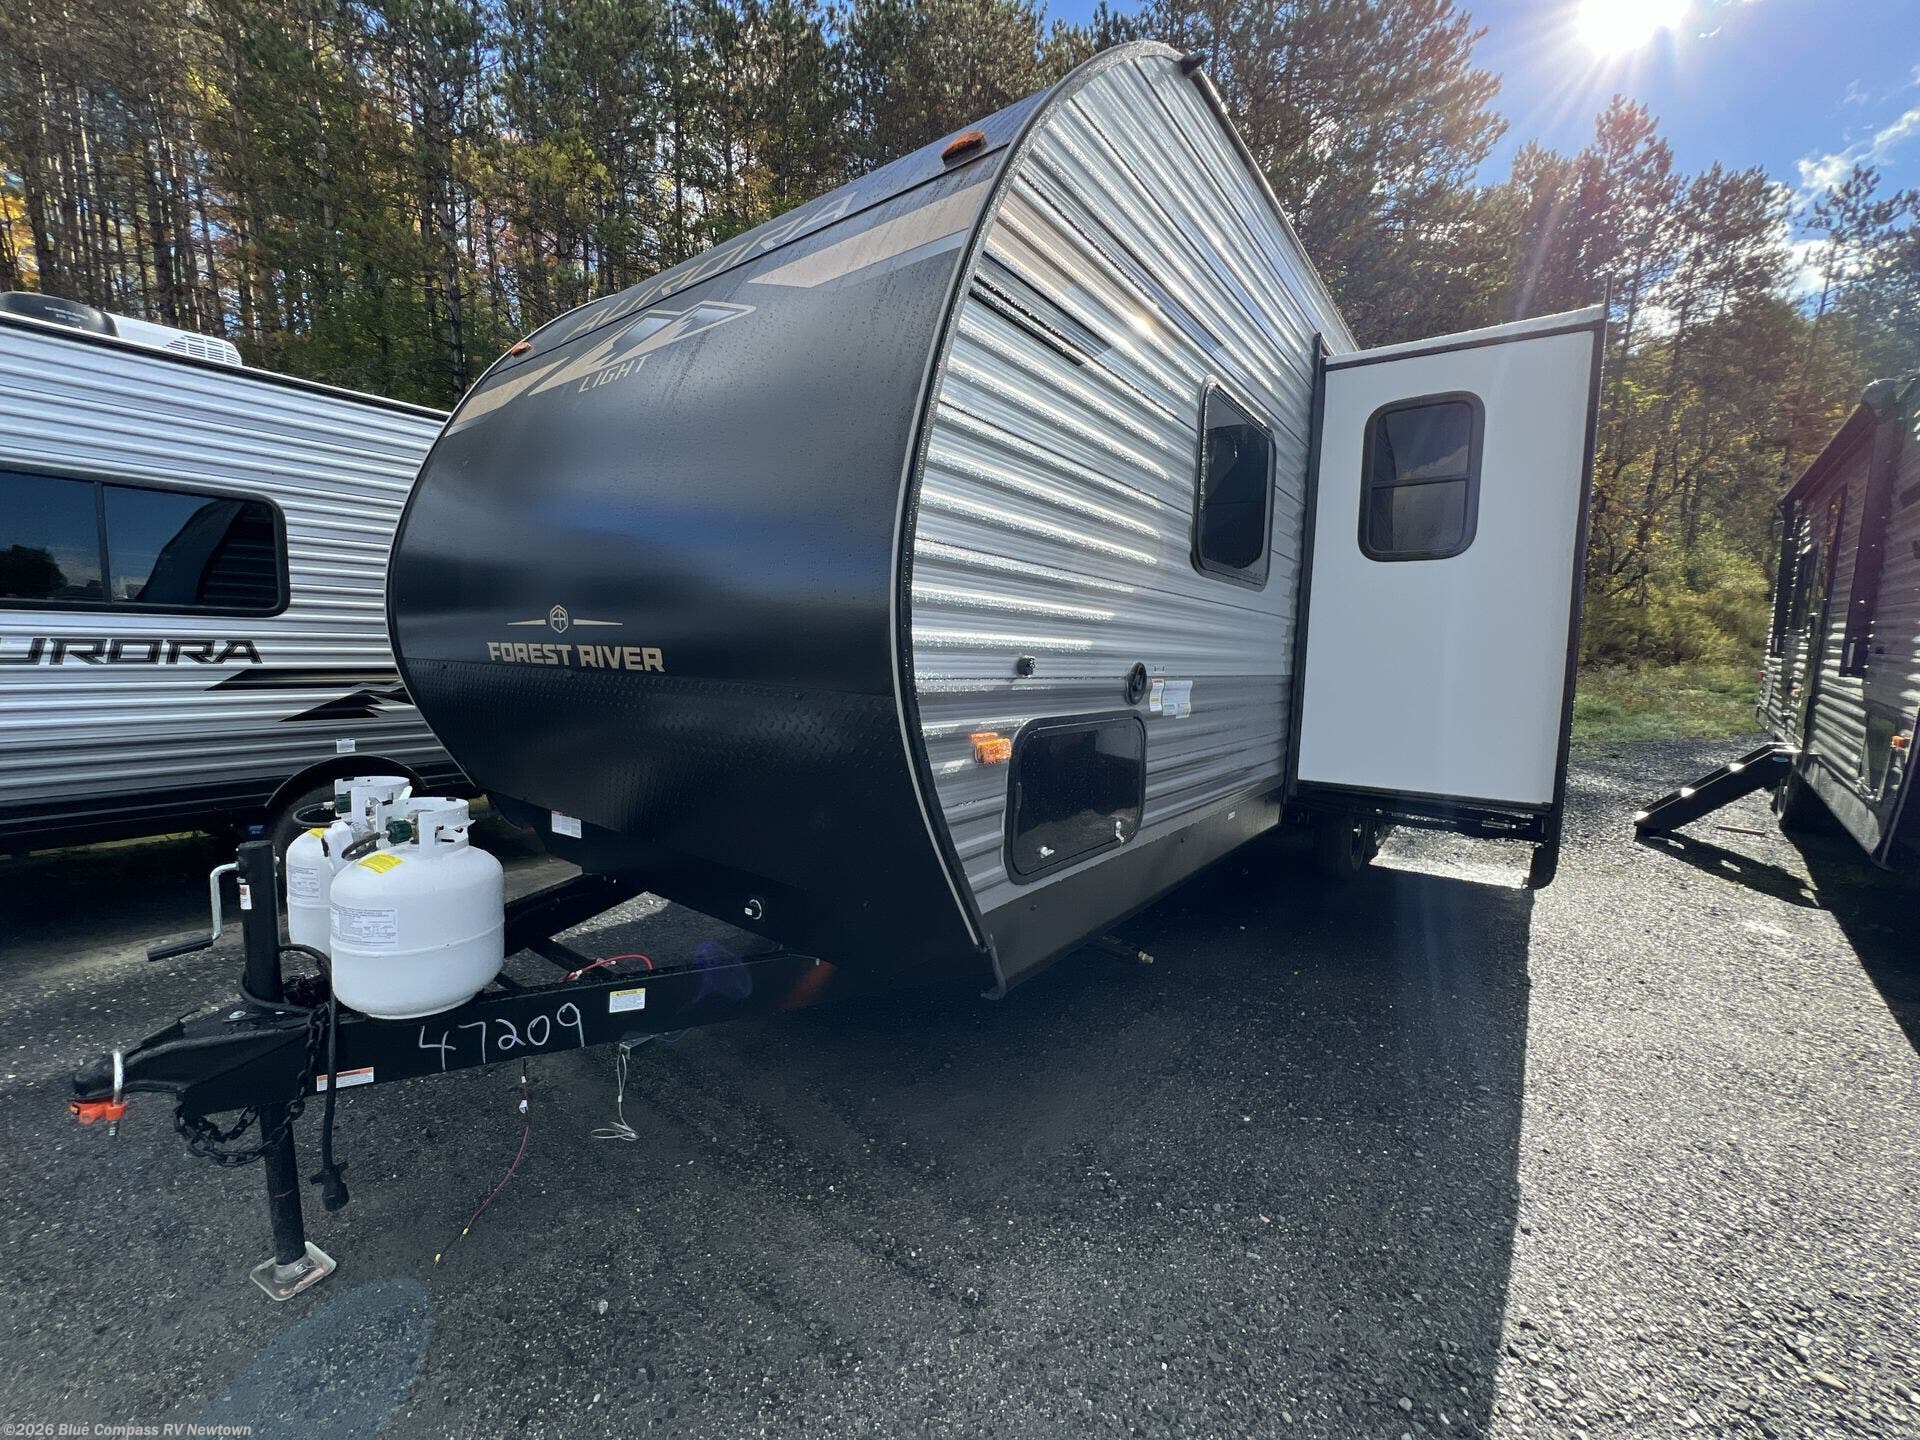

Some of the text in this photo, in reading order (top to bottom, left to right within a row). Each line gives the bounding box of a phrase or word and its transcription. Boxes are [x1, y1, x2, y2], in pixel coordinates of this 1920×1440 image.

[560, 191, 856, 343] AURORA
[578, 353, 653, 393] LIGHT
[486, 641, 666, 673] FOREST RIVER
[418, 1002, 586, 1071] 47209
